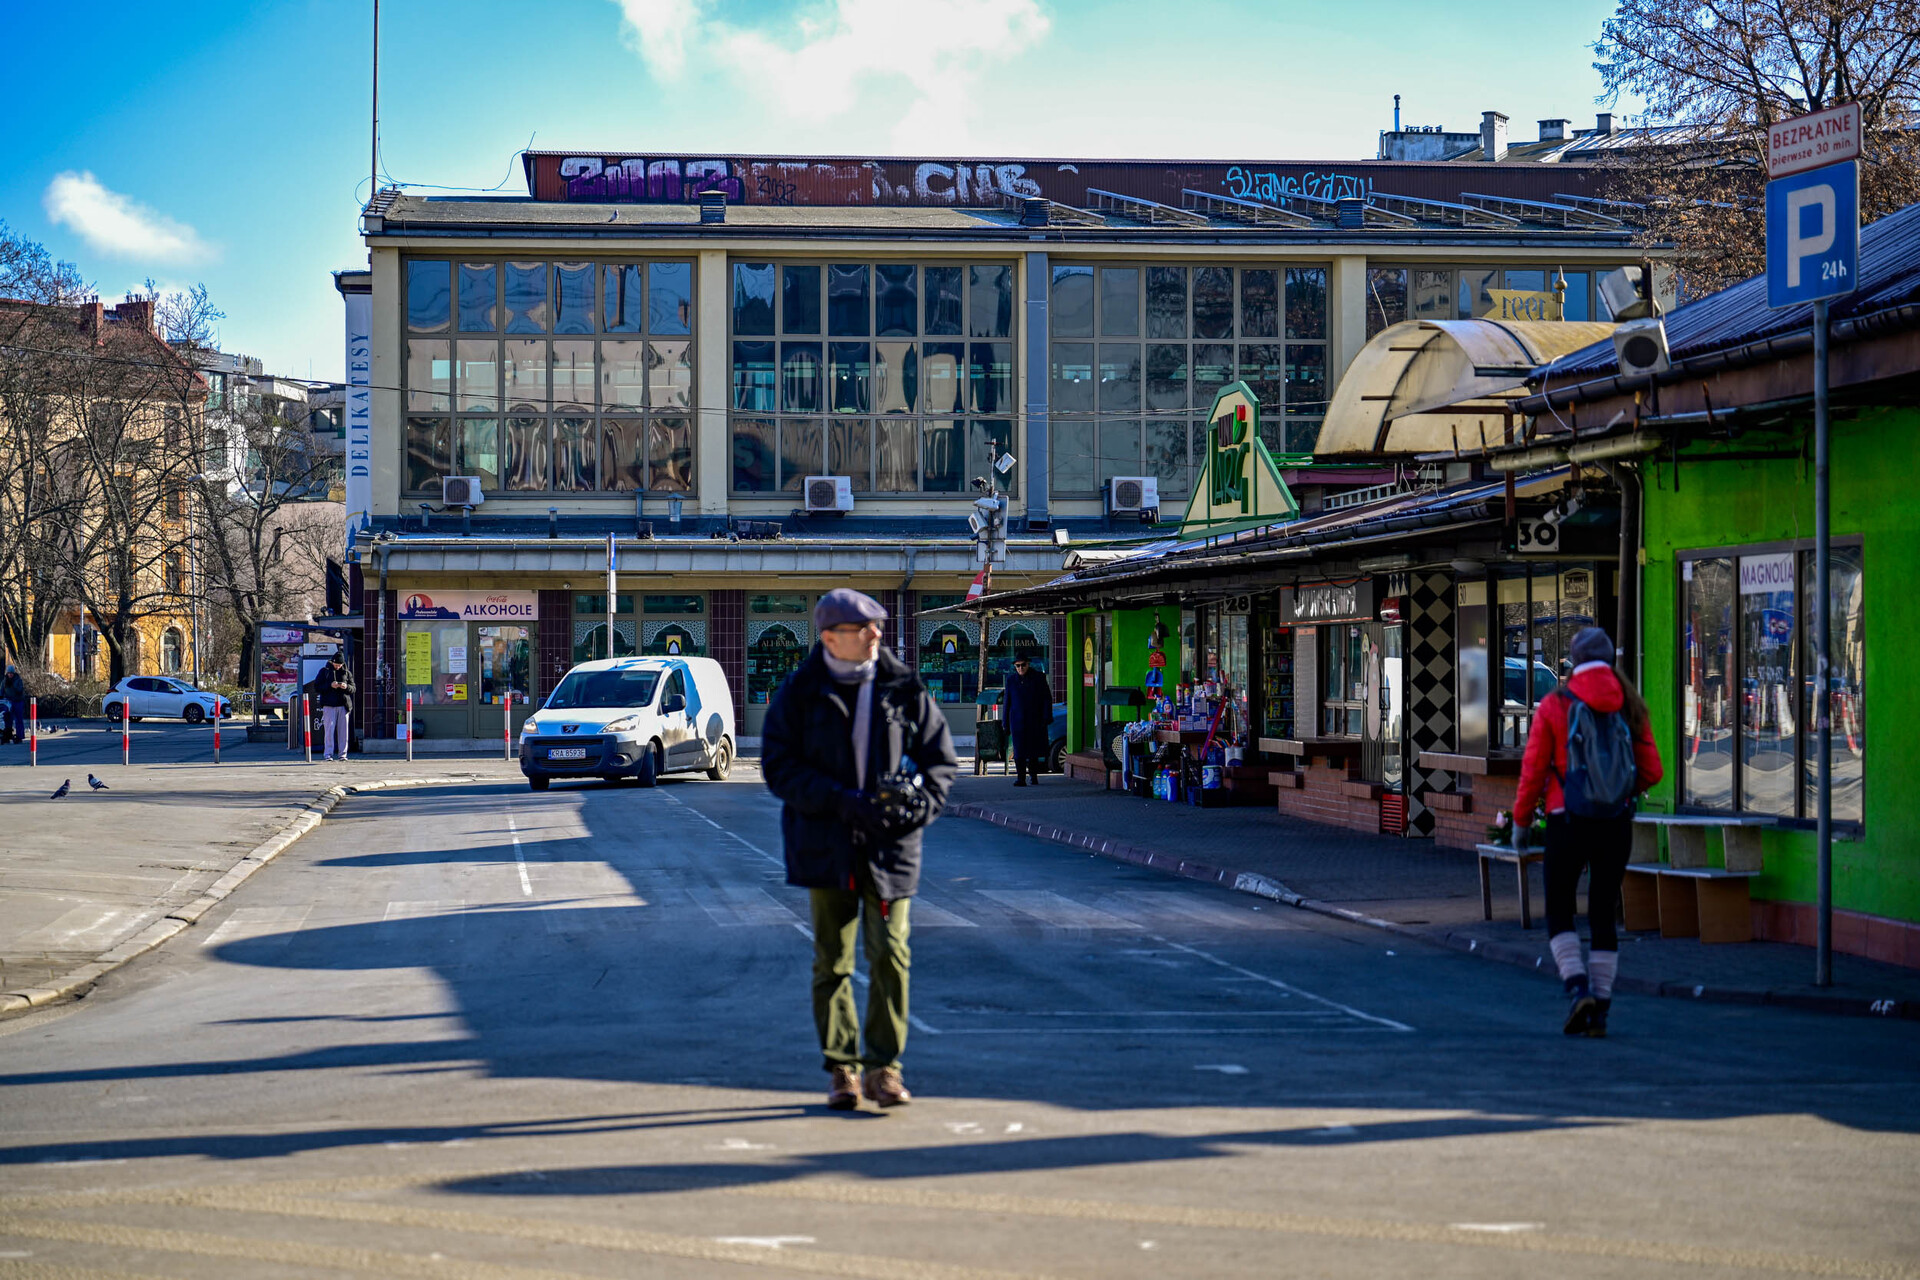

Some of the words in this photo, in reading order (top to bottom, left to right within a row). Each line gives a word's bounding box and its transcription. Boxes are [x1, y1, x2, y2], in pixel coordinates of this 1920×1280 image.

[1772, 114, 1851, 150] BEZPŁATNE
[1771, 148, 1812, 169] pierwsze
[1816, 141, 1829, 156] 30
[1832, 137, 1854, 152] min.
[1786, 183, 1836, 289] P
[1821, 259, 1847, 281] 24h
[351, 332, 369, 477] DELIKATESY
[1519, 522, 1557, 546] 30
[1741, 562, 1795, 586] MAGNOLIA
[463, 604, 532, 616] ALKOHOLE
[1225, 596, 1250, 612] 28
